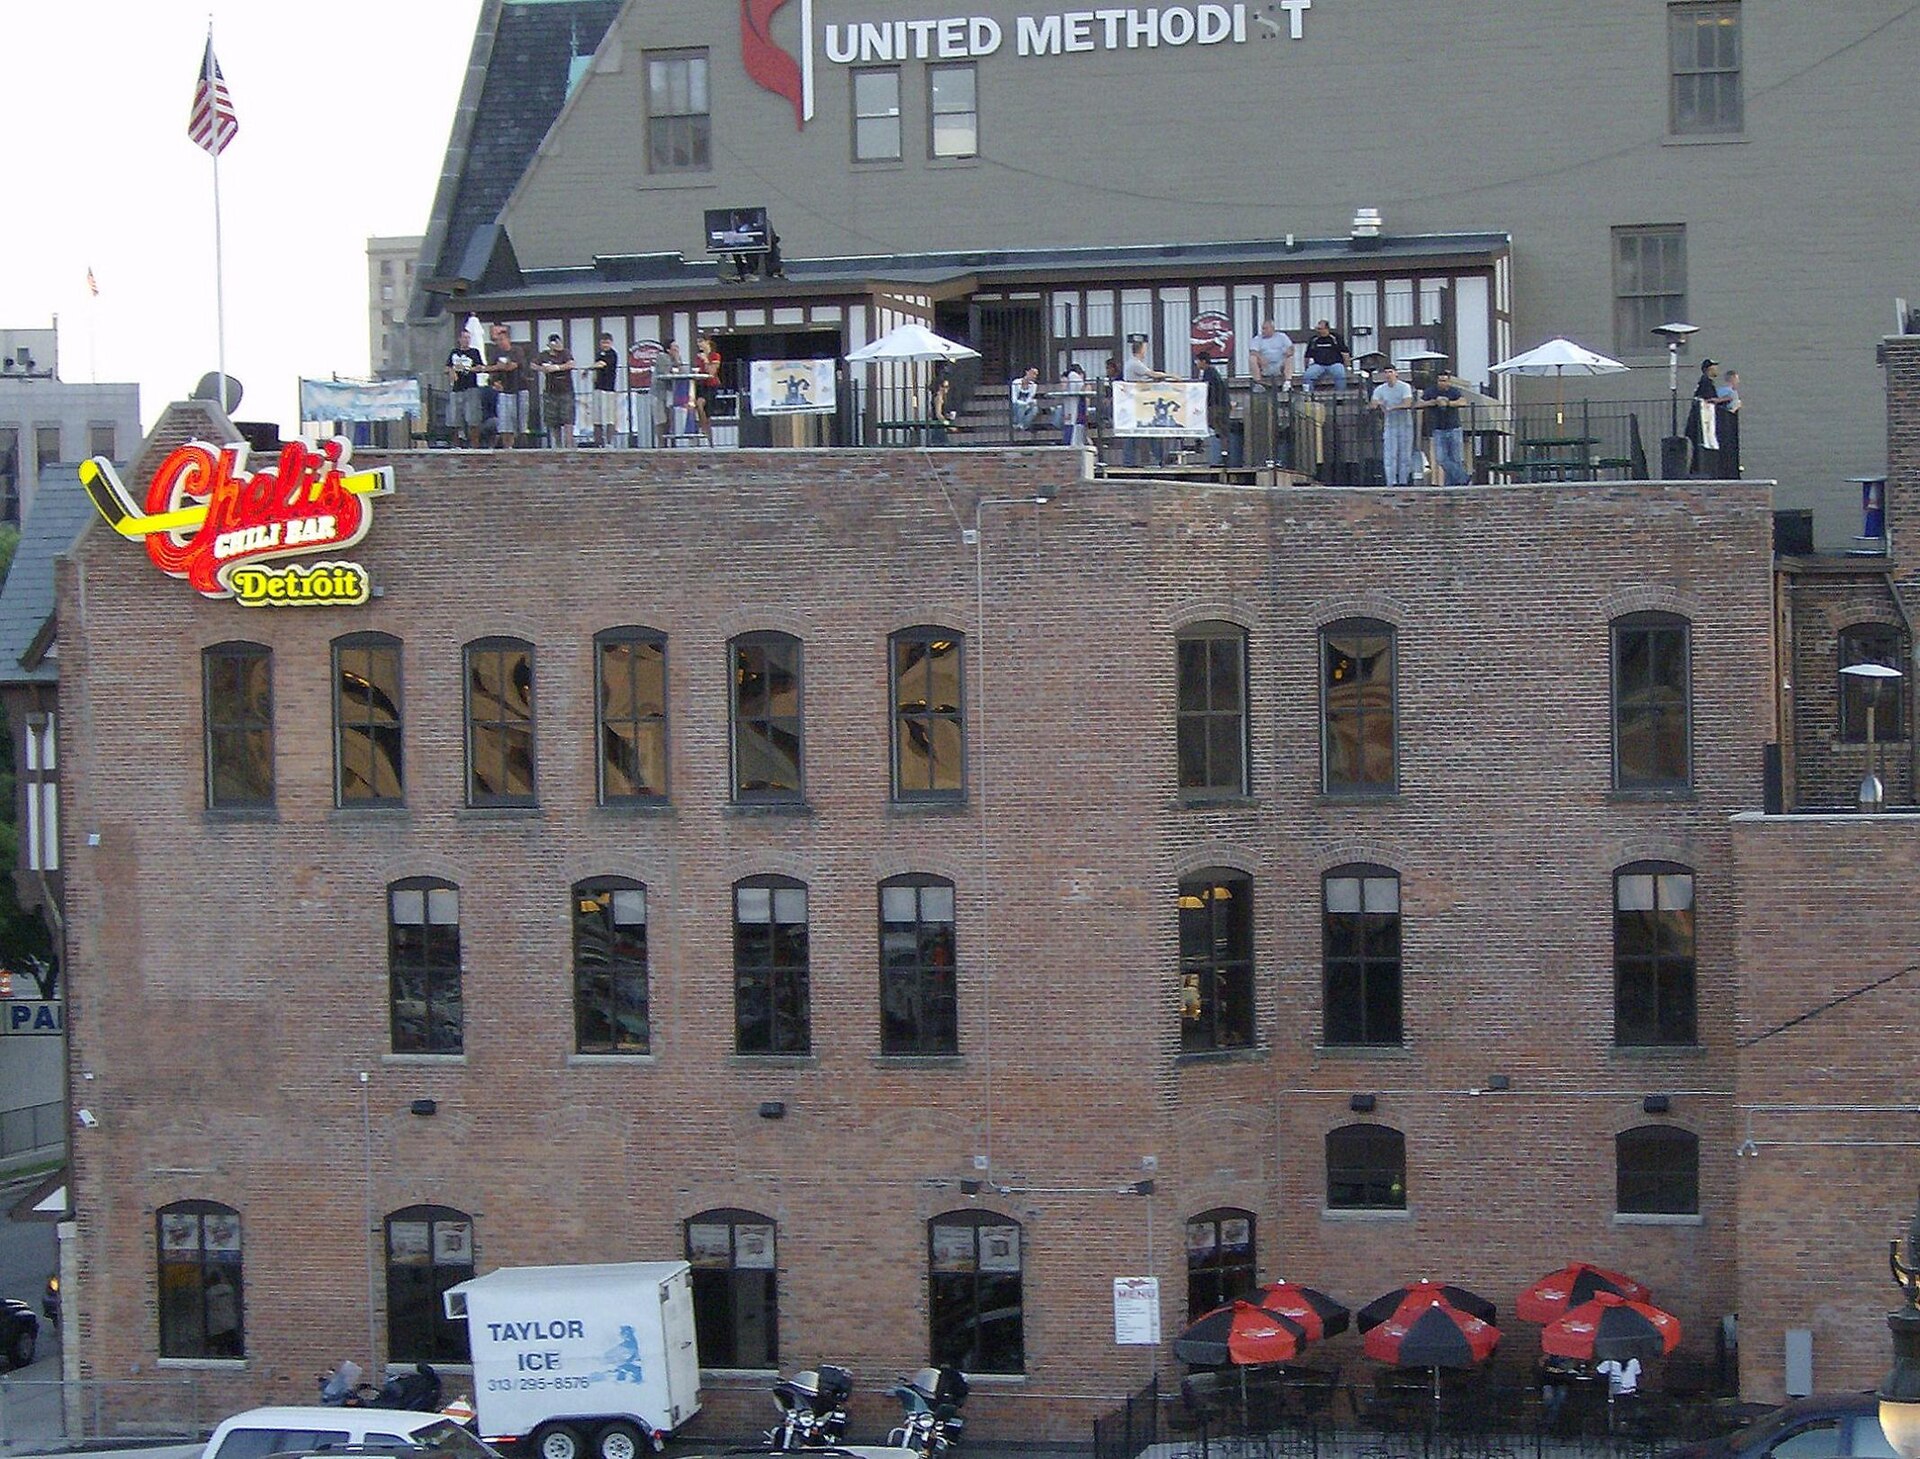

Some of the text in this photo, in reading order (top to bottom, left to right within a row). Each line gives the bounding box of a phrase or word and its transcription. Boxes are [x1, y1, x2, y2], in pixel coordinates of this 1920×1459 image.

[825, 17, 1002, 63] UNITED
[214, 515, 336, 558] CHILI BAR
[234, 568, 358, 598] Detroit
[11, 1005, 63, 1029] PA
[487, 1320, 584, 1341] TAYLOR
[518, 1352, 562, 1371] ICE
